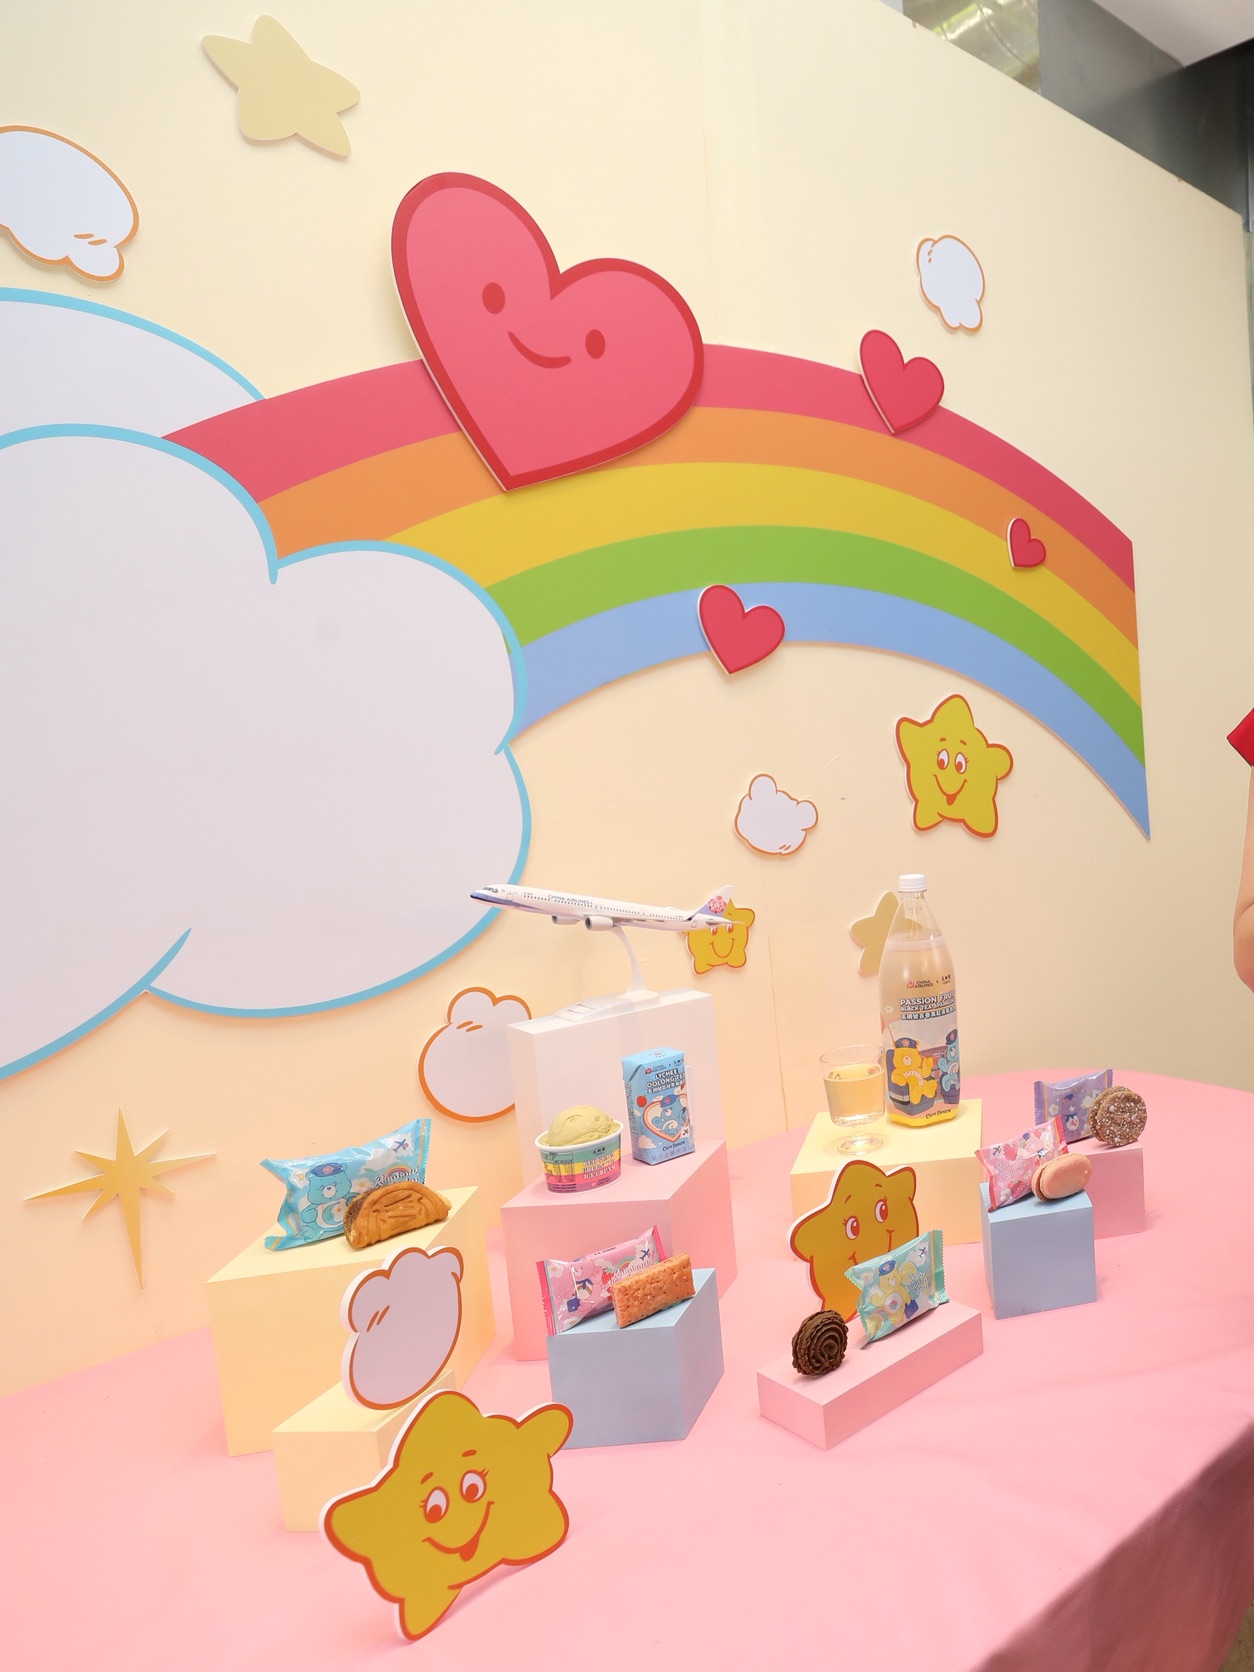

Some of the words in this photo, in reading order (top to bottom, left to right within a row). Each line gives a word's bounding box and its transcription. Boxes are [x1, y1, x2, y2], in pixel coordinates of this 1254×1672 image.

[900, 996, 938, 1006] PASSION
[655, 1068, 678, 1080] LYCHEE
[646, 1077, 675, 1088] OOLONG
